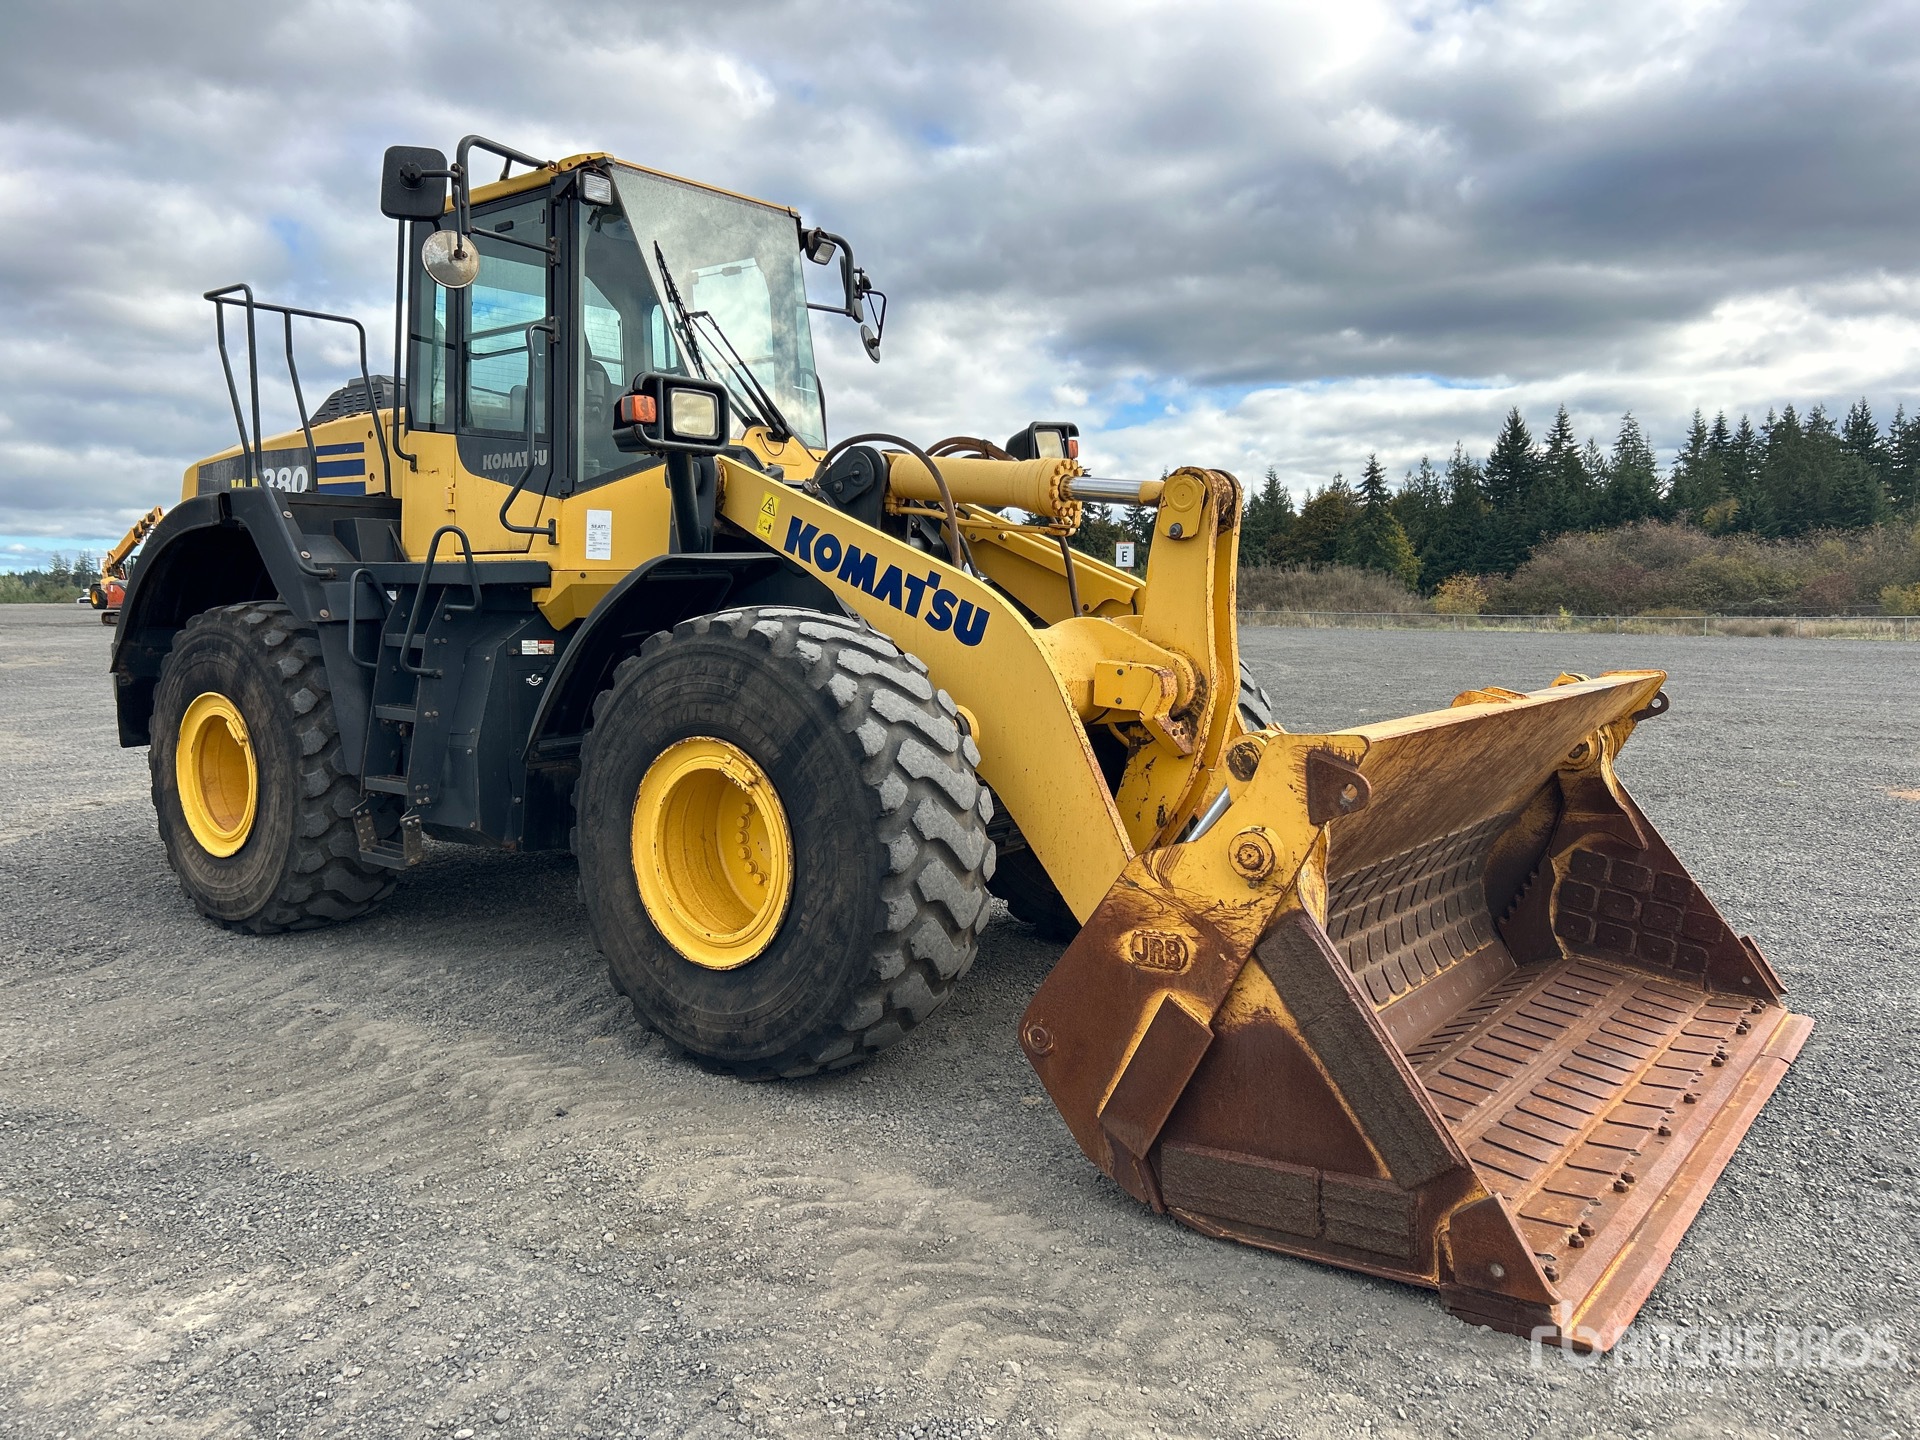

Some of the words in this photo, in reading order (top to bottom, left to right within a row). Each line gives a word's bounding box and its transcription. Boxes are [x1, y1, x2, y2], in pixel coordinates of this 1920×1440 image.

[1121, 551, 1128, 562] E
[783, 515, 990, 646] KOMATSU
[1134, 937, 1181, 965] JRB
